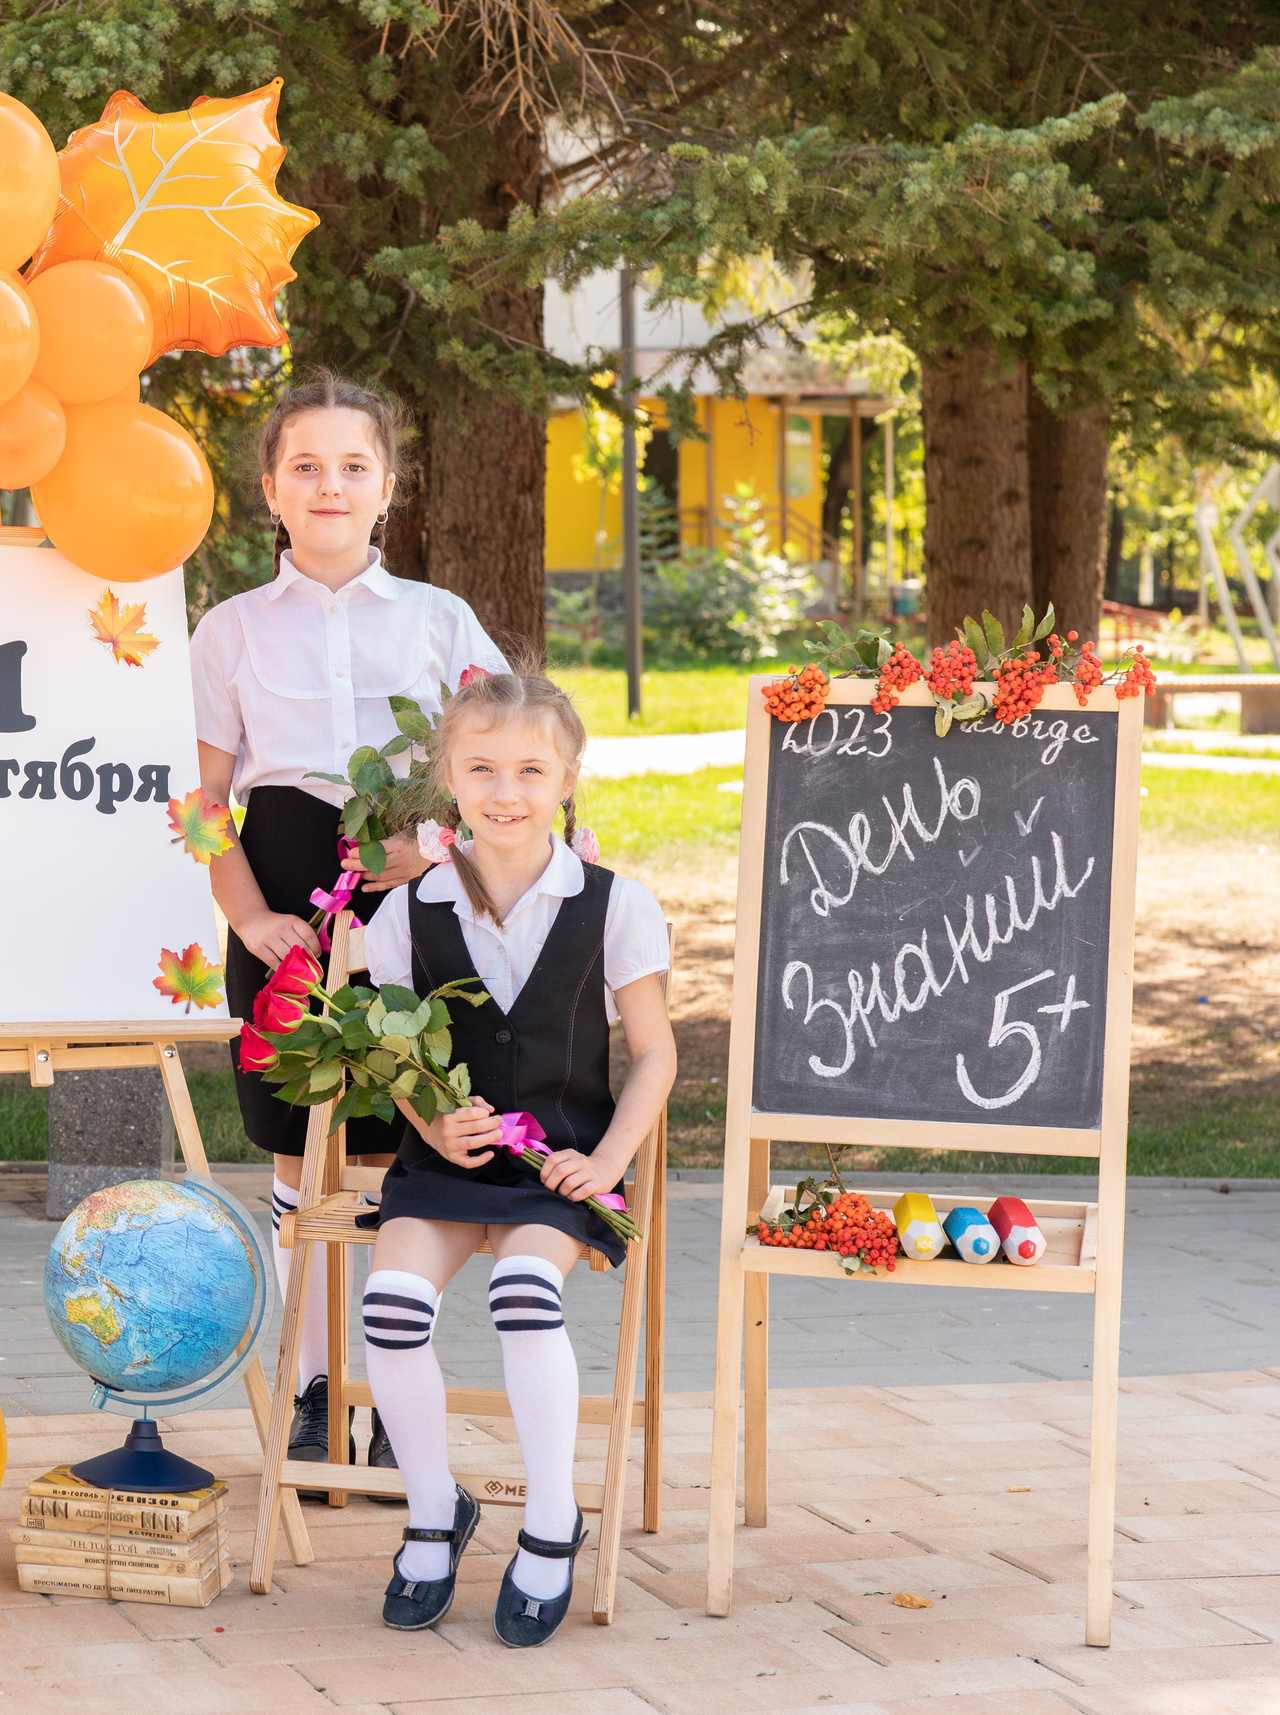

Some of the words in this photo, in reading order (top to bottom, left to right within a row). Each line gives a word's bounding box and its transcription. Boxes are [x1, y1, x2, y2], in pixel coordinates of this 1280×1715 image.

[780, 756, 981, 917] День
[956, 969, 1091, 1110] 5+
[33, 1579, 80, 1588] ХРЕСТОМАТИЯ
[93, 1584, 124, 1593] ДЕТКОЙ
[126, 1587, 167, 1597] ЛИТЕРАТУРЕ
[84, 1557, 127, 1567] КОНСТНТИН
[128, 1561, 160, 1569] СИМОНОВ
